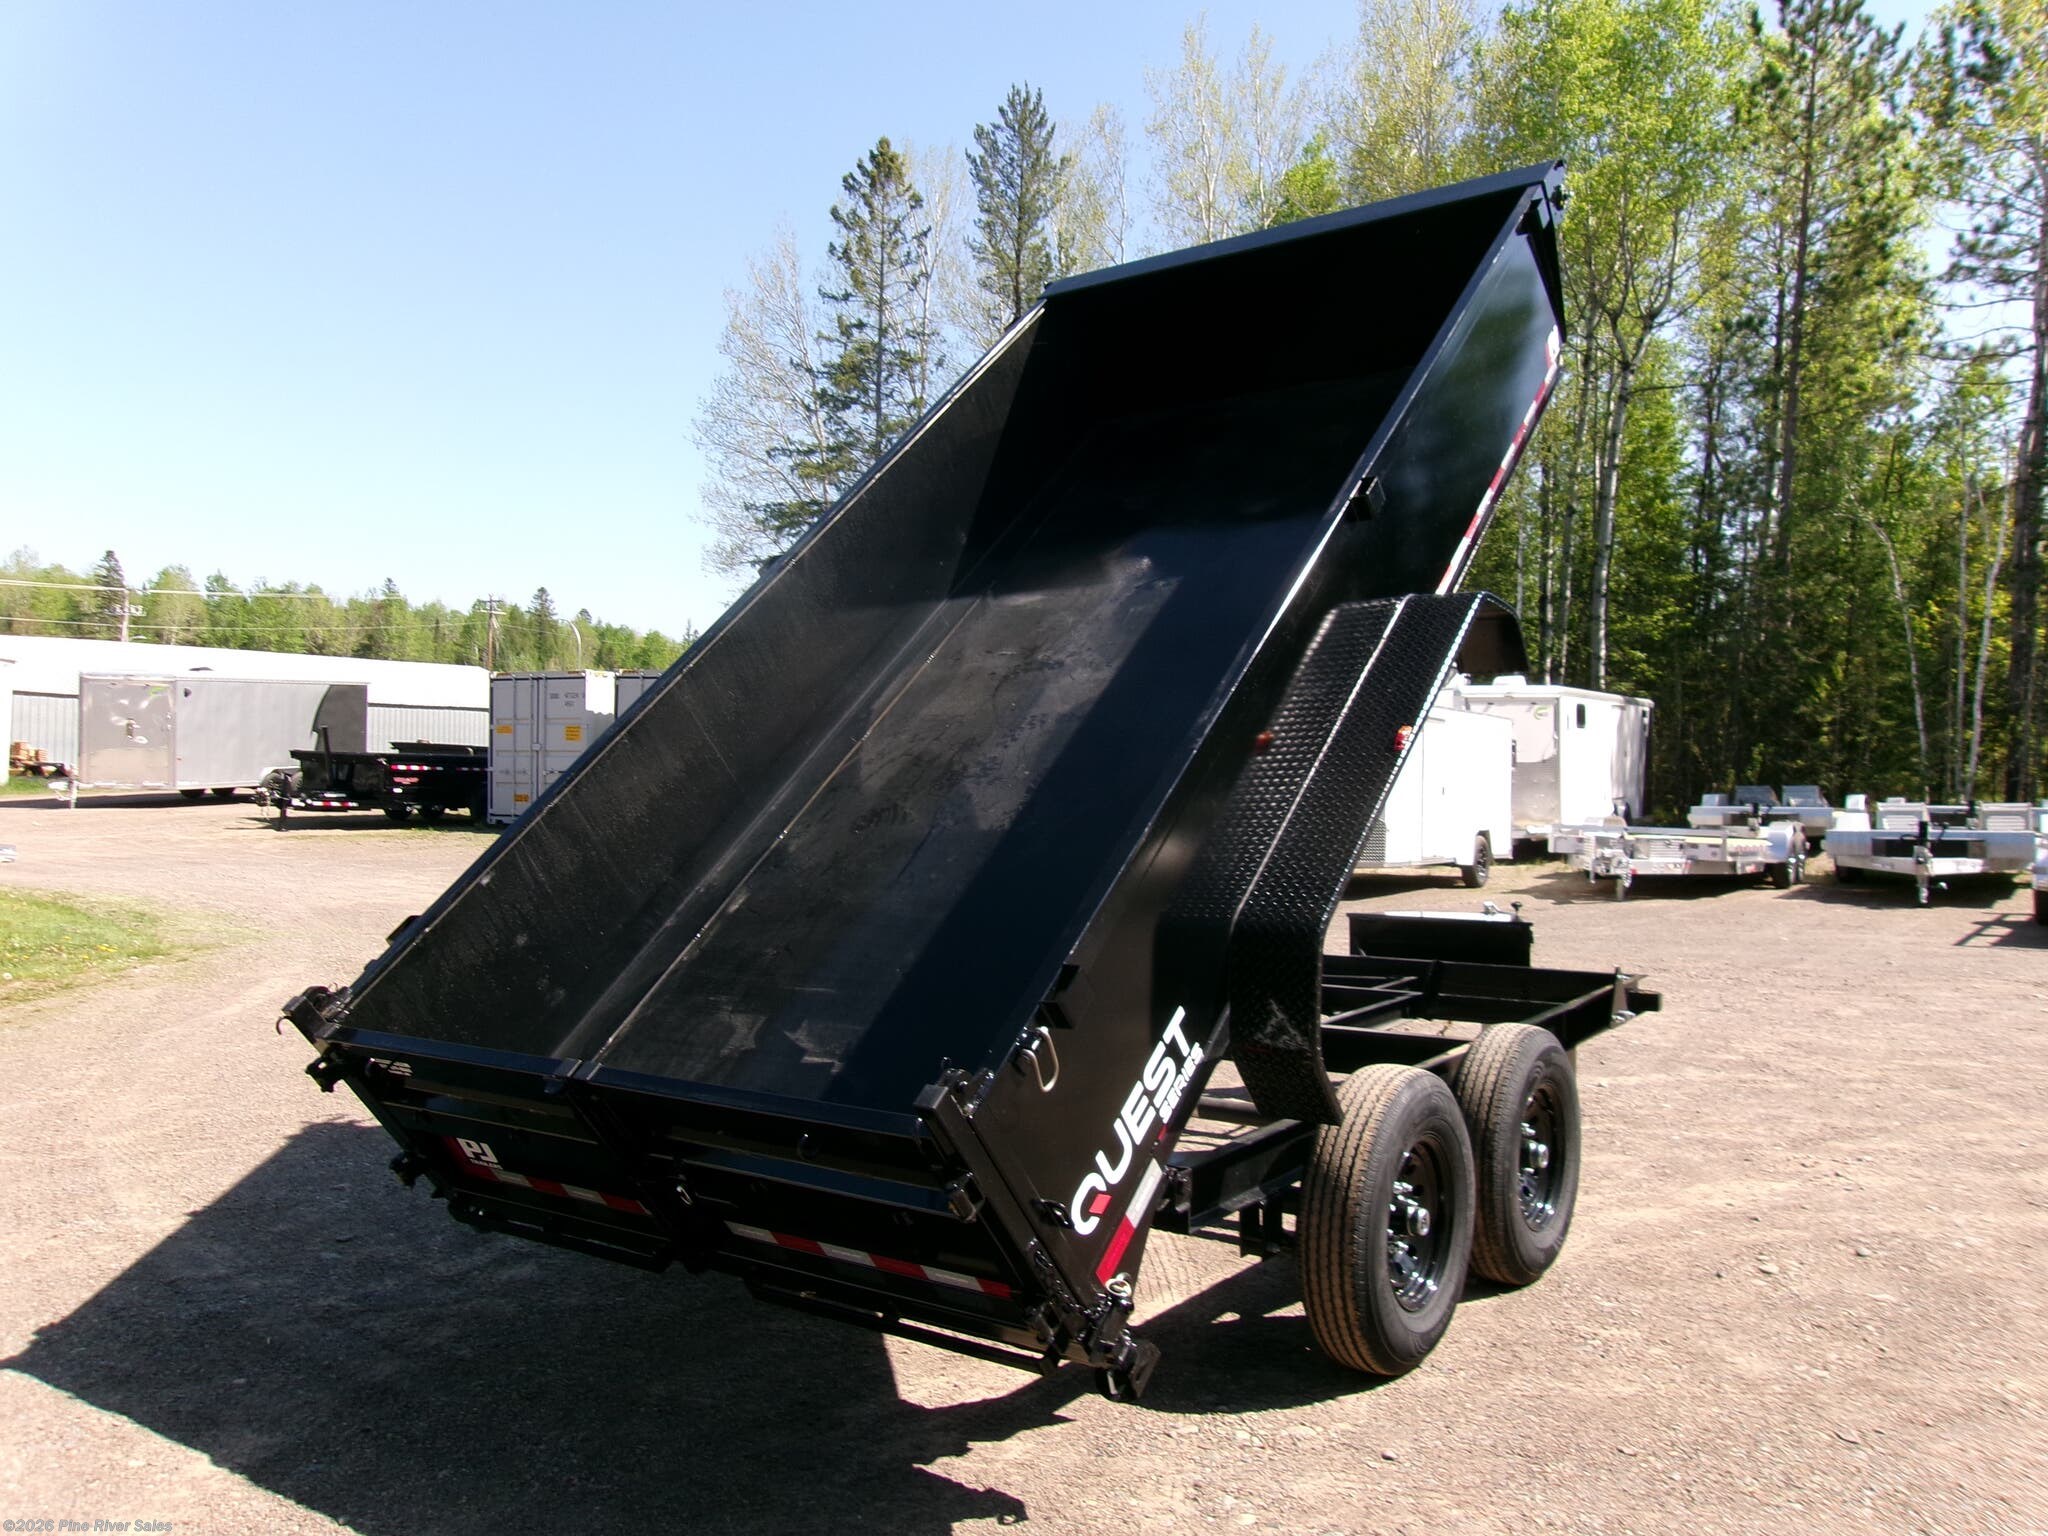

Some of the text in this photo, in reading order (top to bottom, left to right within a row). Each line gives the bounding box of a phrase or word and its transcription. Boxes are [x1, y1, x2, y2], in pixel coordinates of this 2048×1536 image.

[1071, 1005, 1190, 1236] QUEST
[1158, 1041, 1205, 1125] SERIES
[456, 1137, 499, 1163] PJ
